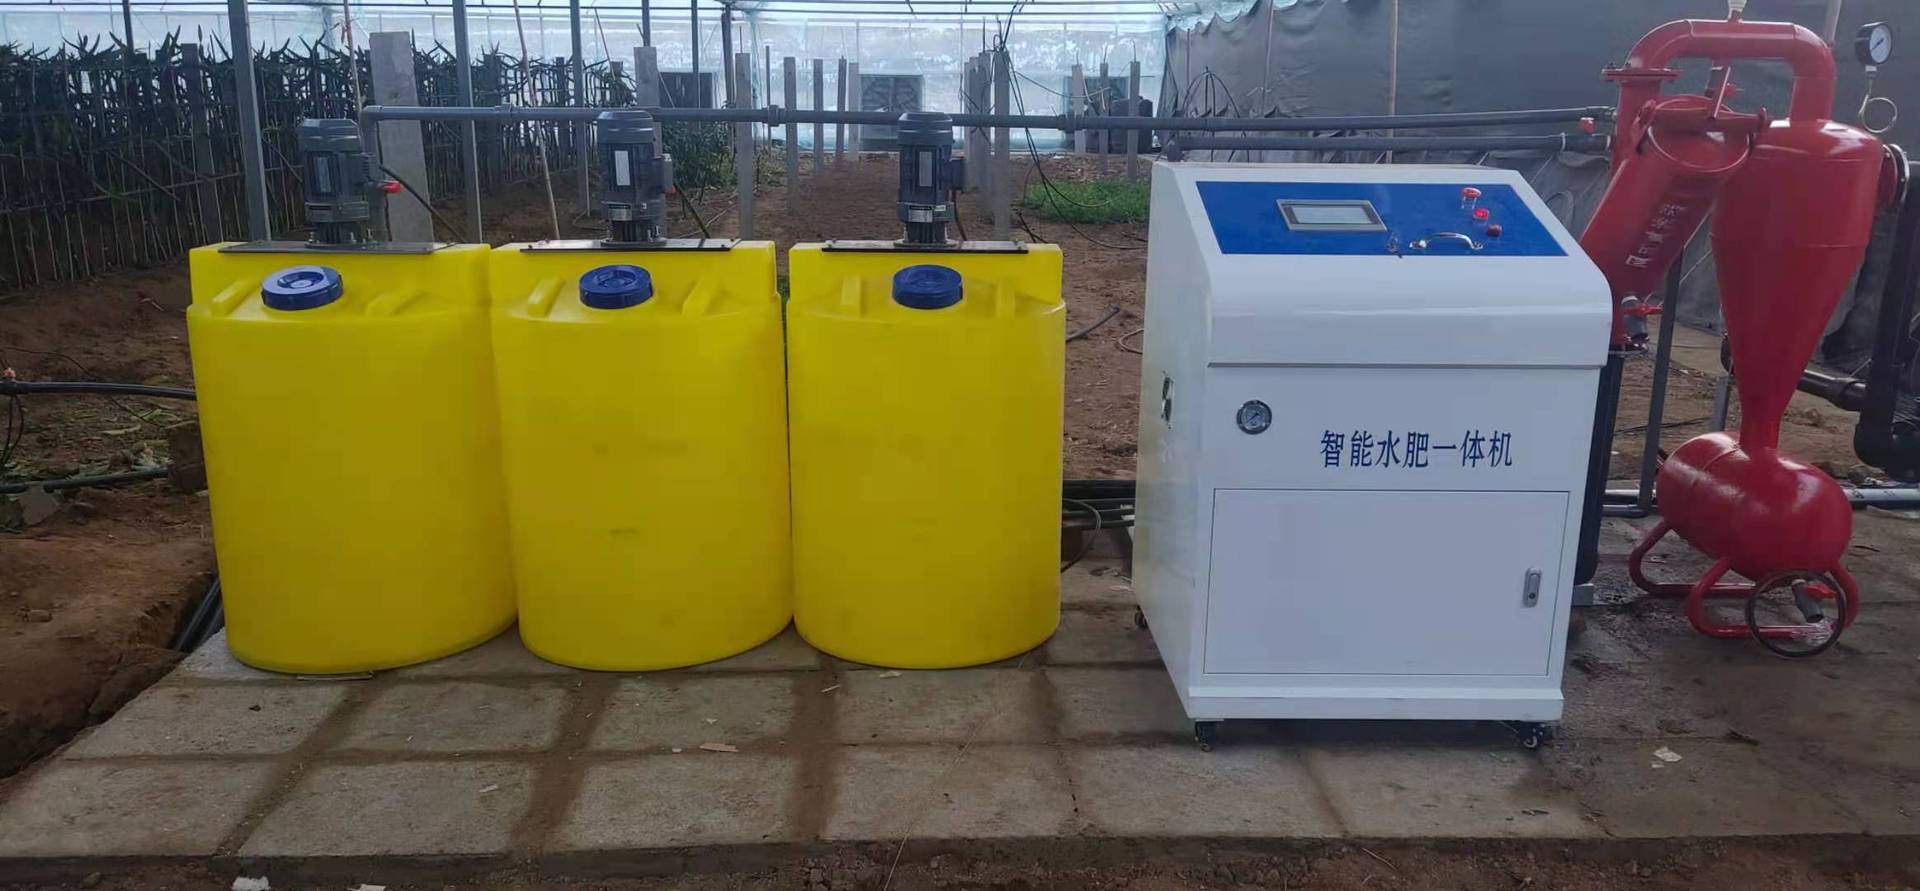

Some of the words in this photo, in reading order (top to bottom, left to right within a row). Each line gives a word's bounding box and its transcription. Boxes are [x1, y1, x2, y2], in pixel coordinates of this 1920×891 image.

[1320, 429, 1513, 469] 智能水肥一体机
